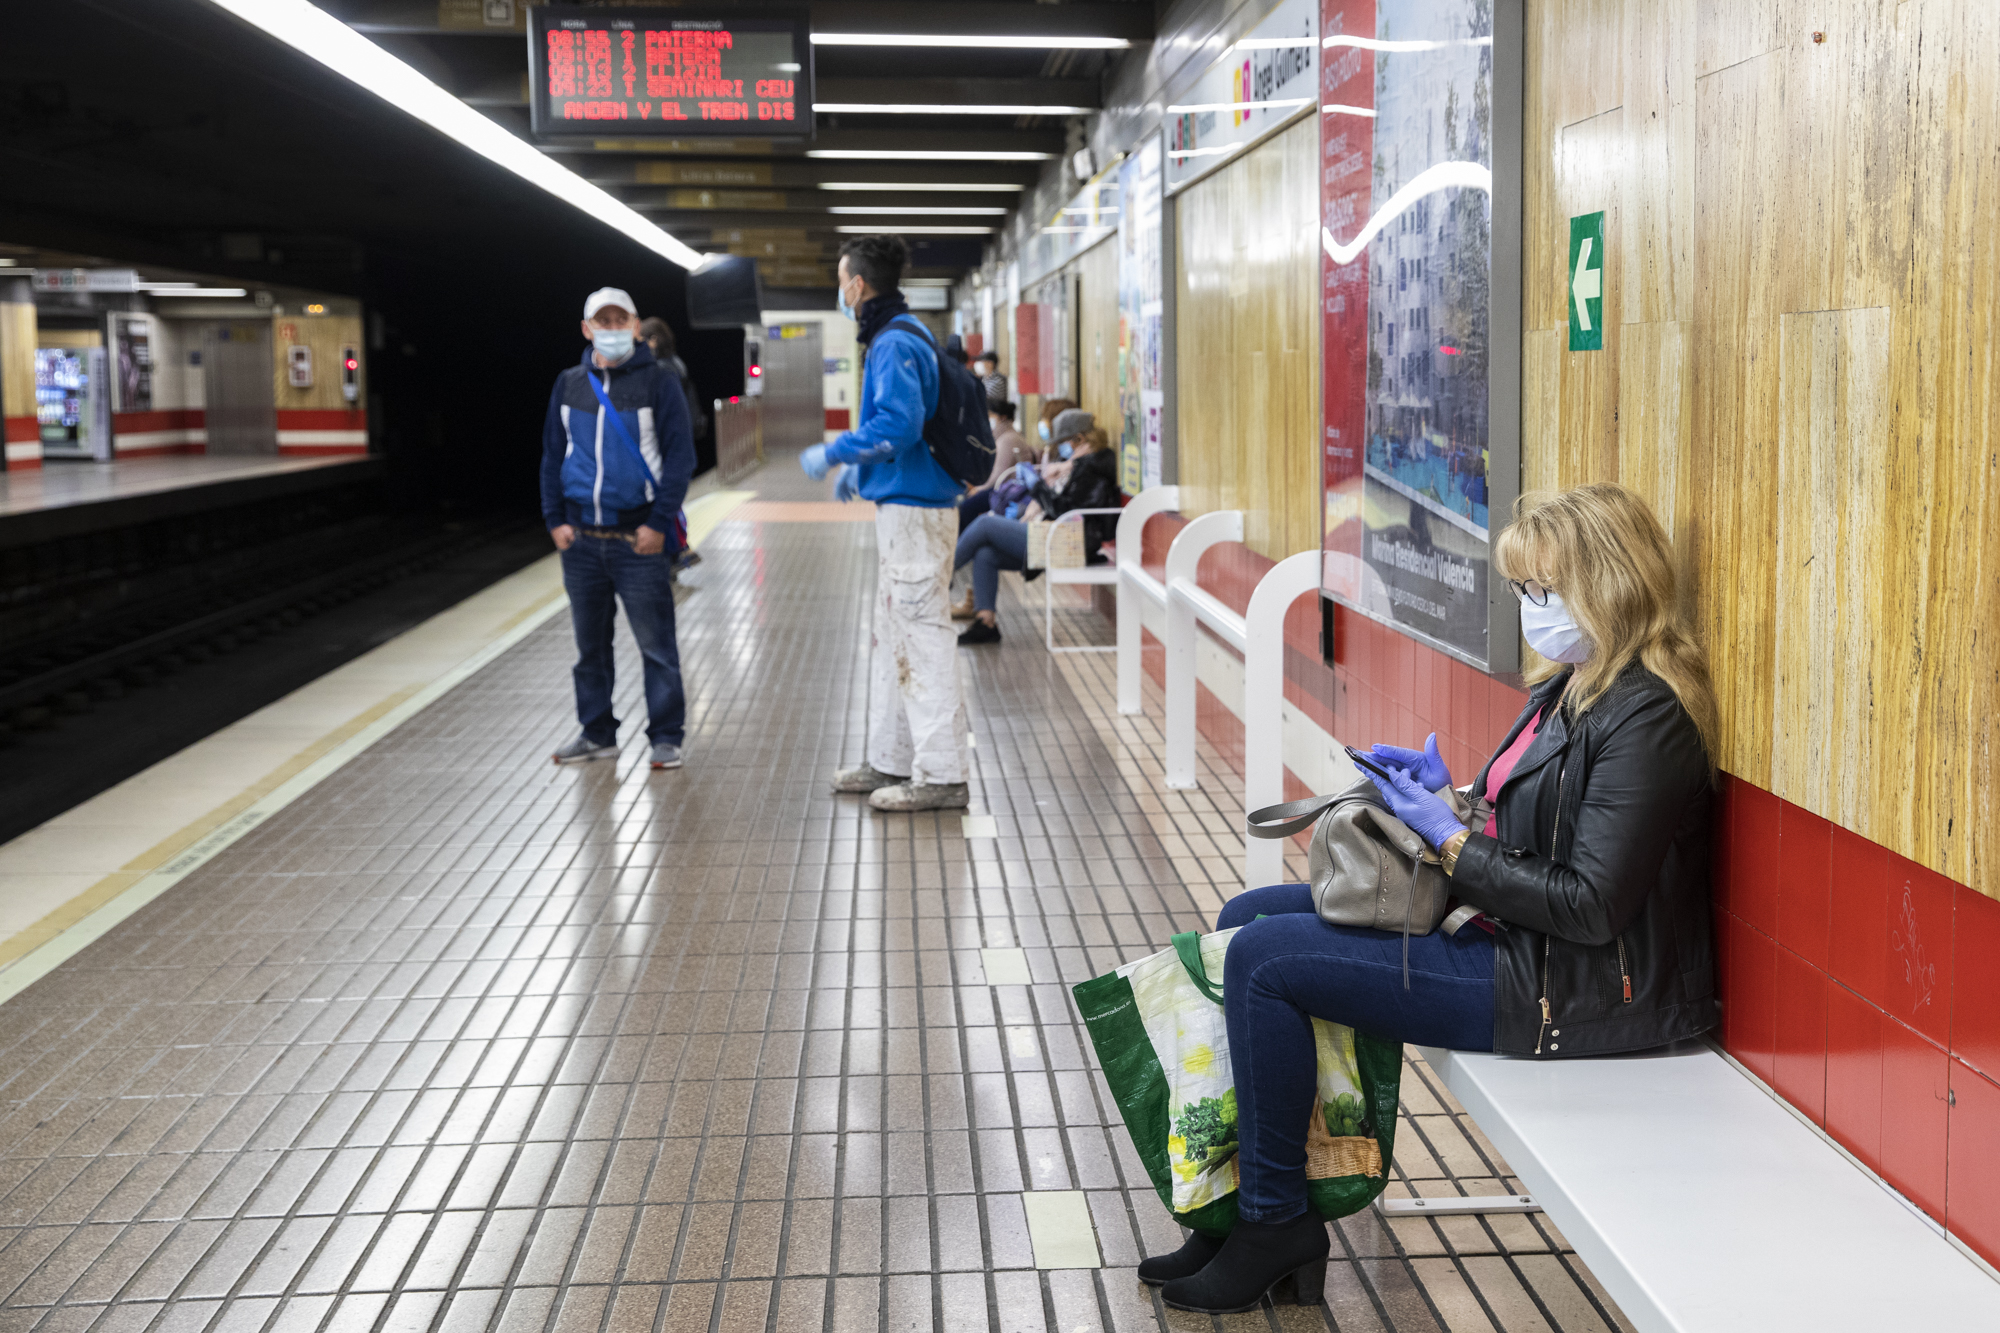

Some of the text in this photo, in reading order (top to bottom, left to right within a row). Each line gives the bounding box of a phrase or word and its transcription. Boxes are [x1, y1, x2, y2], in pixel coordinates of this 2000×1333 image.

[621, 30, 635, 48] 2
[645, 30, 733, 49] PATERNA
[624, 48, 634, 65] 1
[646, 47, 721, 65] BETERA
[622, 65, 636, 81] 2
[625, 81, 635, 97] 1
[647, 79, 744, 97] SEMINARI
[755, 79, 794, 98] CEU
[564, 102, 628, 120] ANDEN
[637, 102, 651, 120] Y
[661, 102, 688, 120] EL
[698, 102, 748, 120] TREN
[1371, 533, 1395, 567] Marina
[1395, 540, 1437, 581] Residencial
[1437, 554, 1475, 594] Valencia
